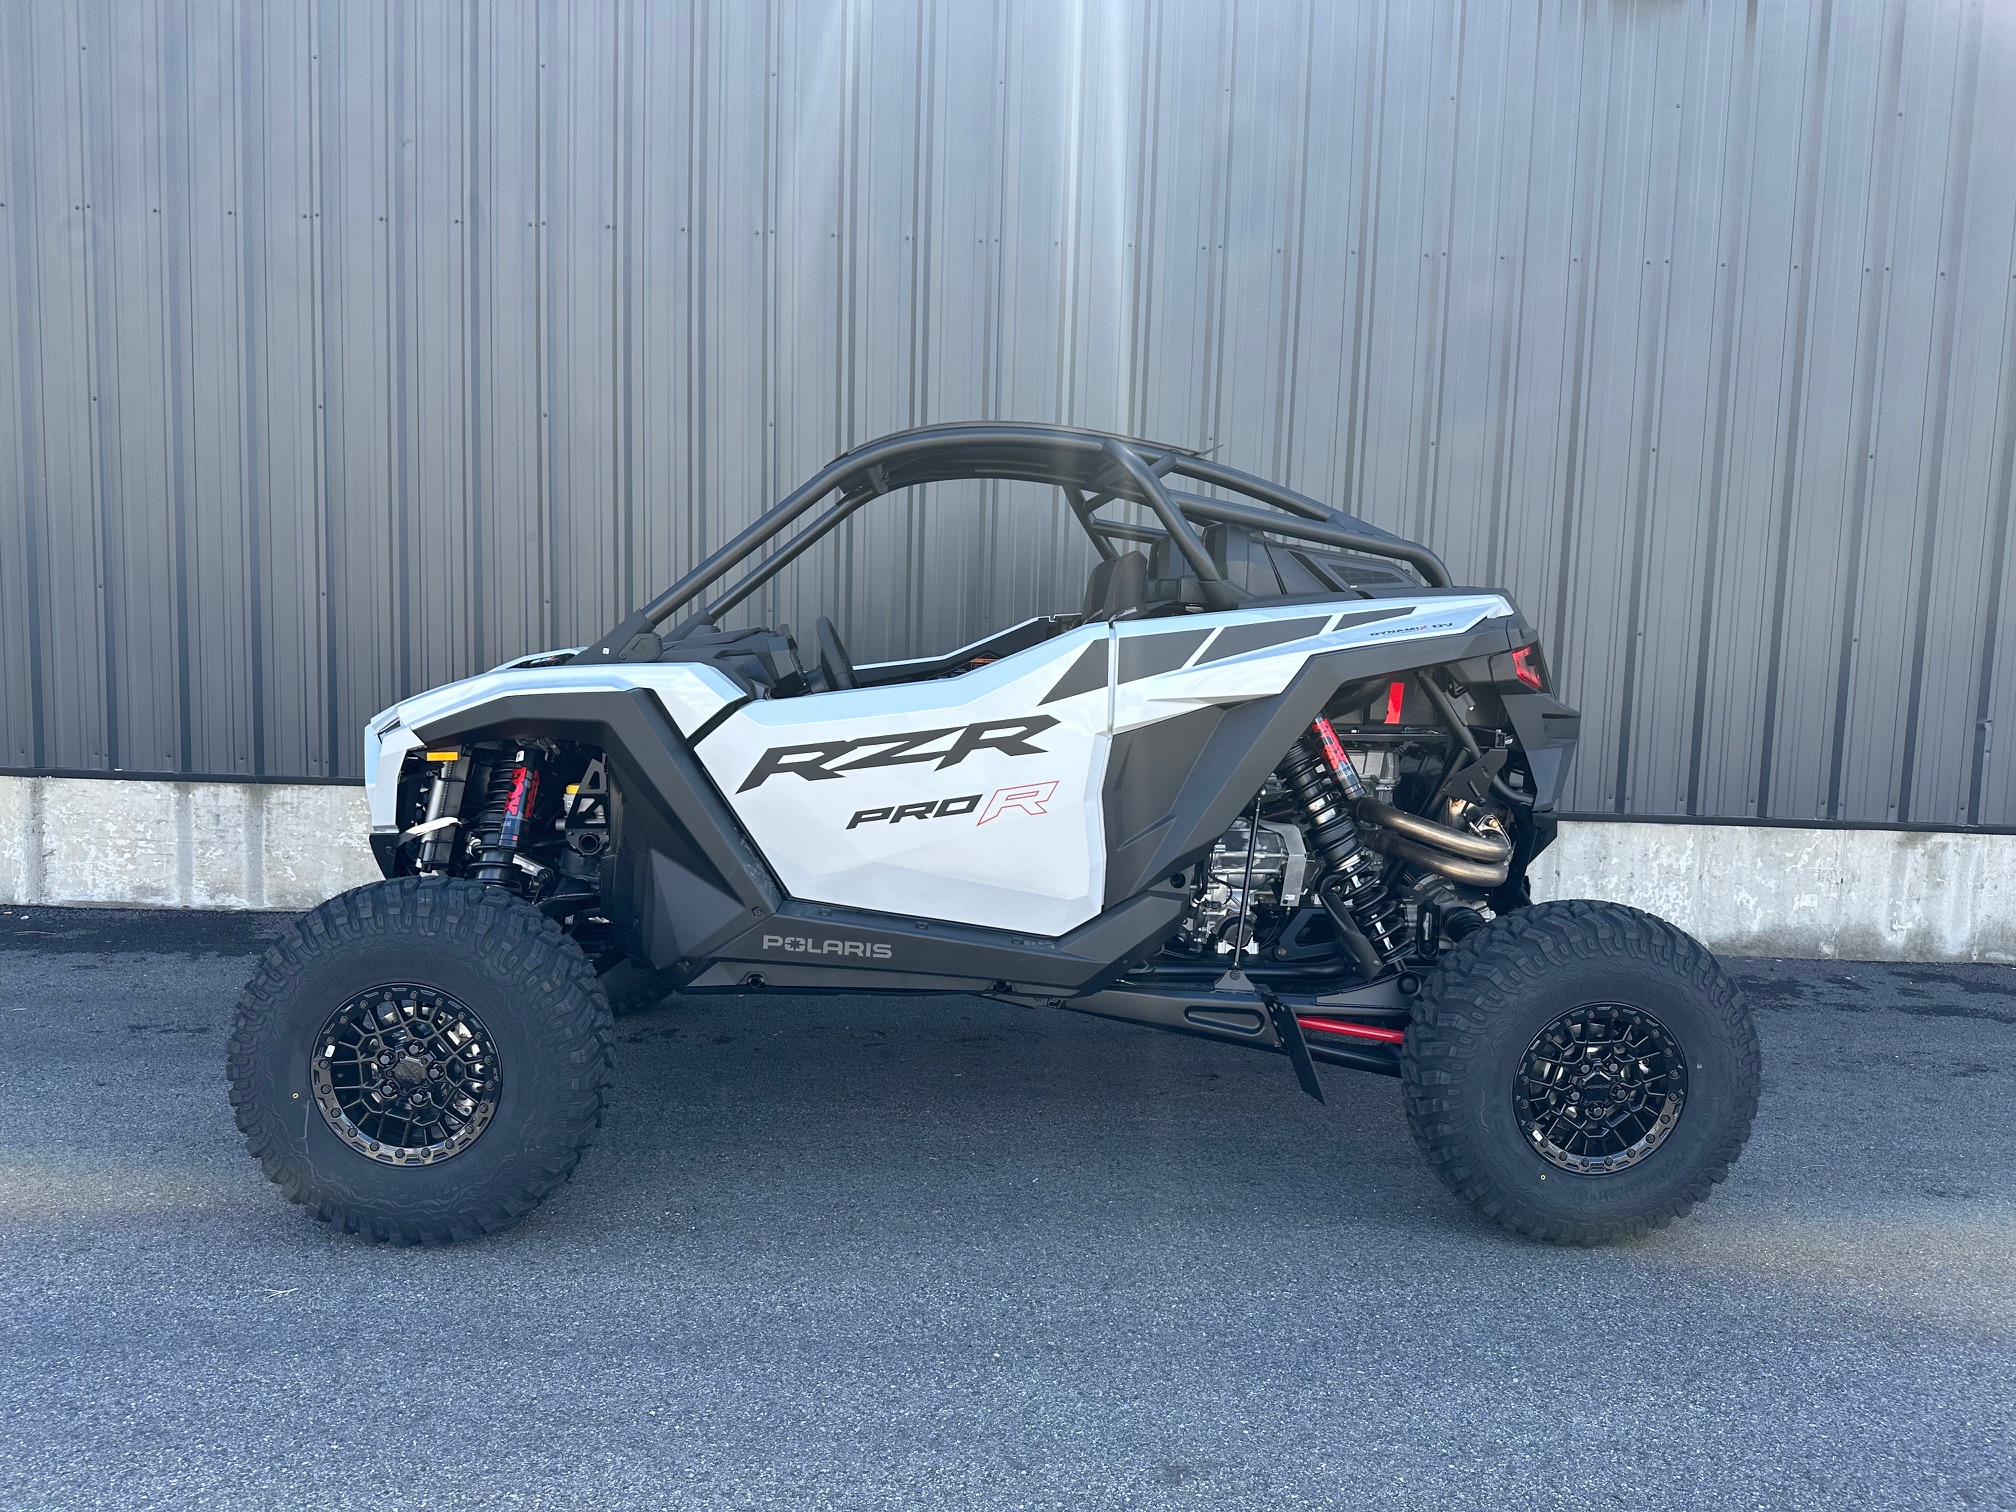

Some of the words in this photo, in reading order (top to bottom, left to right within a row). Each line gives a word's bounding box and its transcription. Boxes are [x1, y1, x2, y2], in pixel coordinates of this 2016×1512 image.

[1370, 625, 1427, 636] DYNAMIX
[735, 714, 1061, 794] RZR
[504, 766, 527, 815] FOX
[845, 794, 983, 830] PRO
[976, 780, 1059, 826] R
[762, 934, 893, 959] POLARIS
